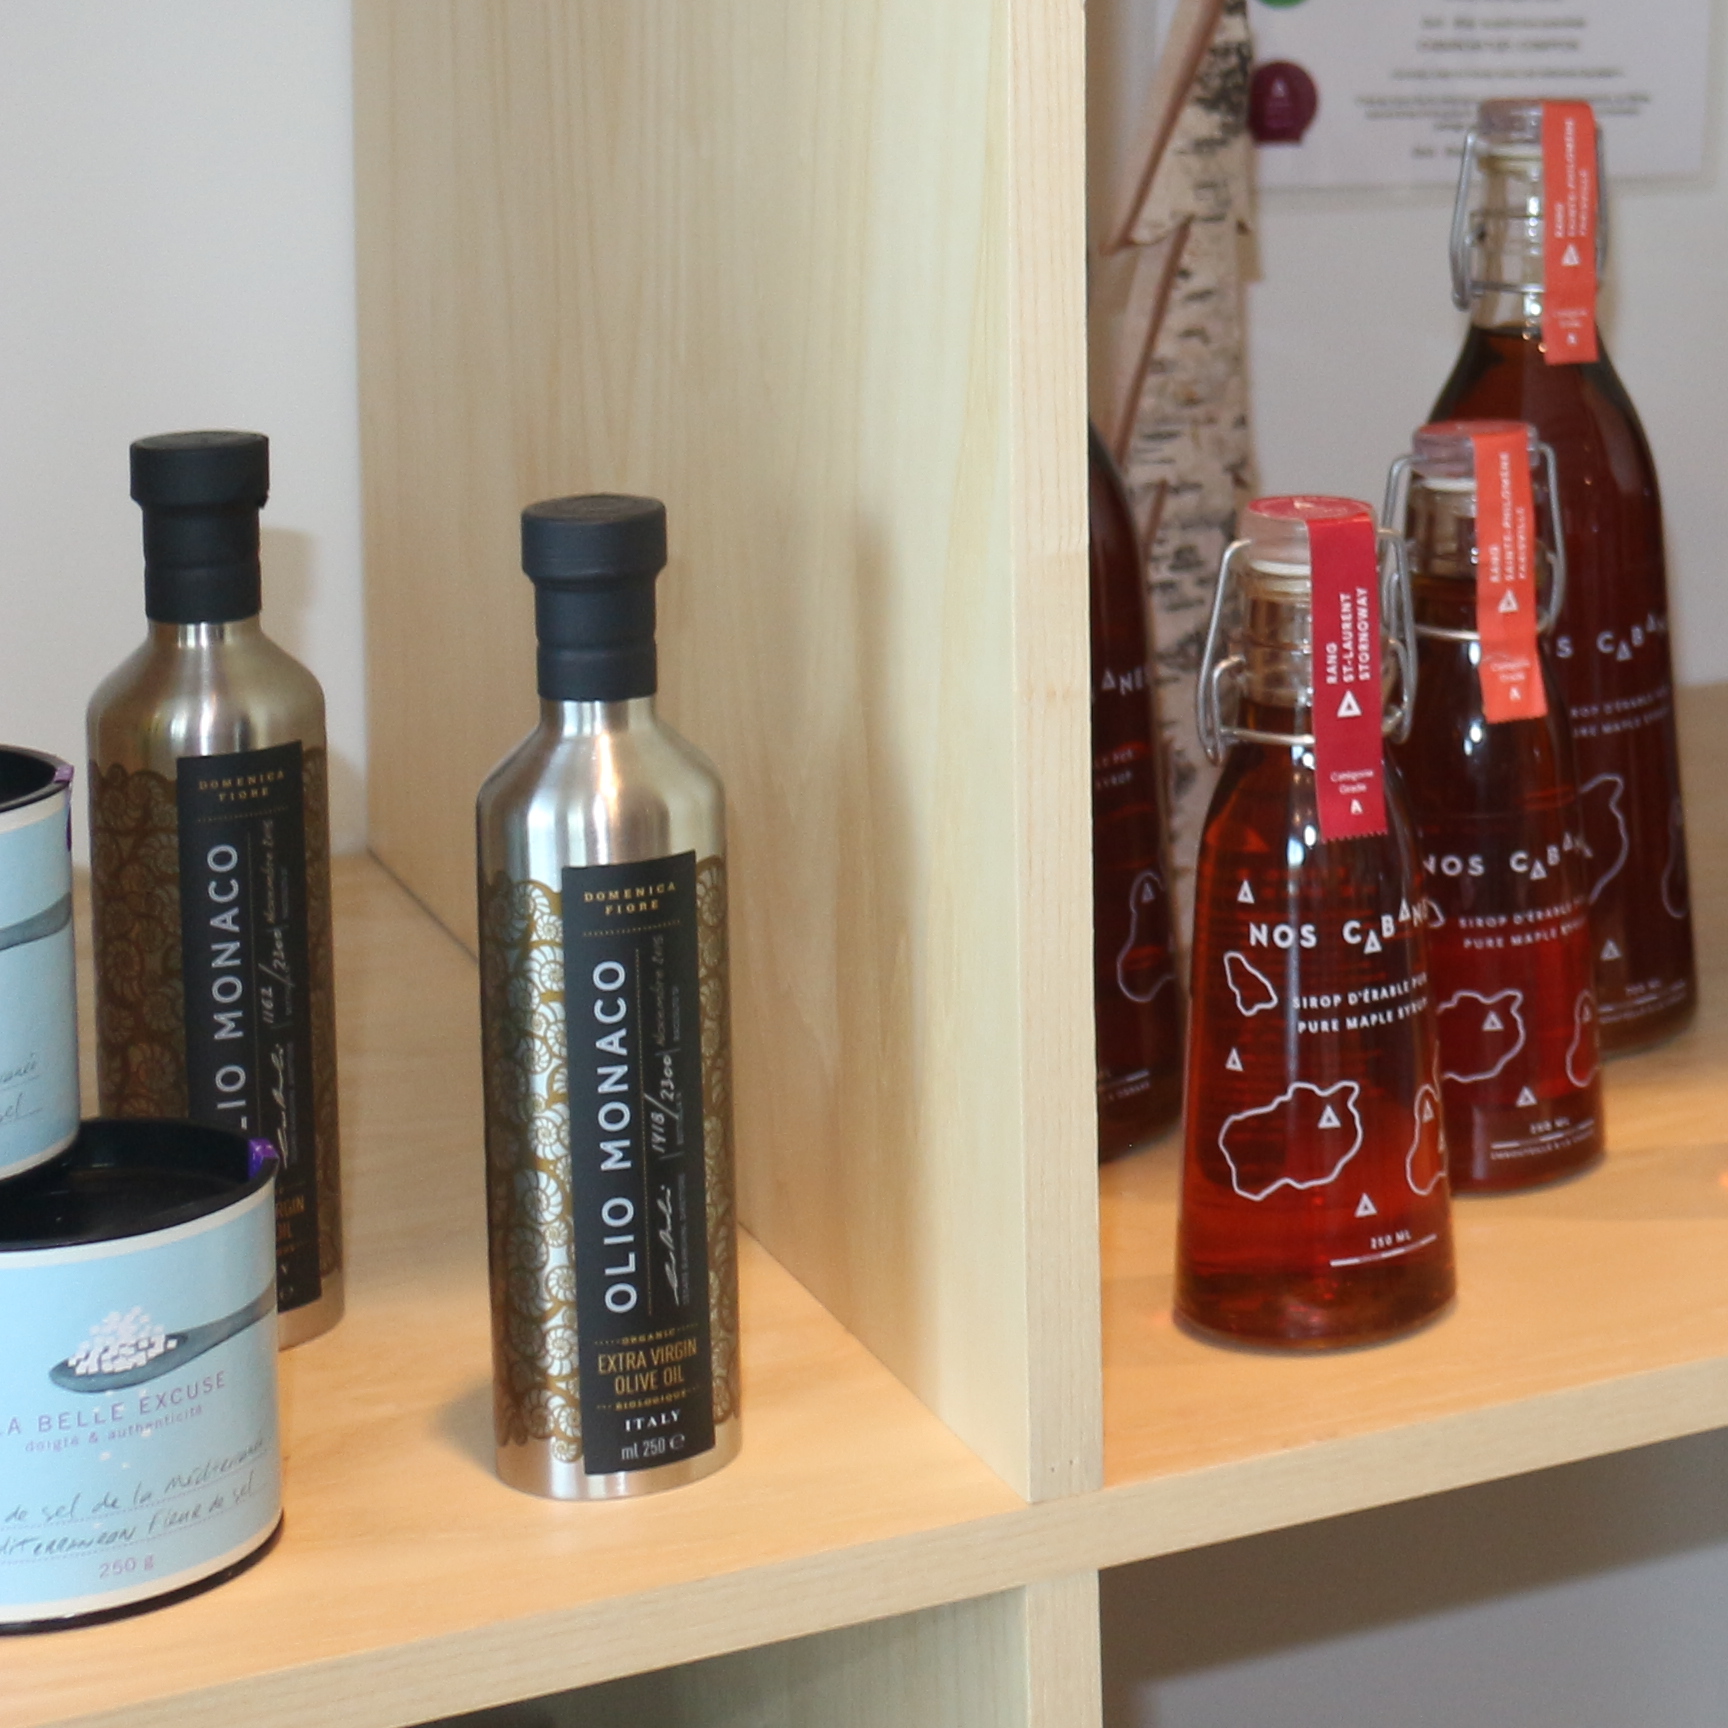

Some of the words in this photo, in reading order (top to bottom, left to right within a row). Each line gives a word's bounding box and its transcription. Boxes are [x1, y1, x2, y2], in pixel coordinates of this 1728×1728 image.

[1339, 592, 1355, 684] ST-LAURENT
[1356, 586, 1371, 681] STORNOWAY
[1596, 612, 1666, 662] CABA
[1326, 642, 1338, 685] RANG
[198, 769, 286, 791] DOMENICA
[218, 786, 270, 803] FIORE
[1350, 798, 1364, 815] A
[1422, 853, 1486, 877] NOS
[1508, 831, 1590, 881] CABA
[583, 881, 677, 904] DOMENICA
[604, 898, 660, 916] FIORE
[1249, 922, 1318, 949] NOS
[1342, 897, 1427, 955] CABAN
[1458, 915, 1507, 929] SIROP
[206, 843, 245, 1041] MONACO
[1462, 936, 1505, 950] PURE
[1509, 927, 1559, 947] MAPLE
[1292, 993, 1343, 1010] SIROP
[1348, 978, 1410, 1007] D'ÉRABLE
[1296, 1018, 1340, 1034] PURE
[1345, 1009, 1394, 1030] MAPLE
[592, 959, 633, 1172] MONACO
[600, 1196, 638, 1314] OLIO
[597, 1350, 648, 1375] EXTRA
[649, 1337, 698, 1366] VIRGIN
[614, 1368, 659, 1396] OLIVE
[662, 1364, 686, 1386] OIL
[38, 1401, 126, 1433] BELLE
[138, 1370, 227, 1417] EXCUSE
[624, 1409, 681, 1432] ITALY
[87, 1429, 99, 1445] &
[621, 1441, 639, 1460] ml
[642, 1436, 666, 1457] 250
[99, 1556, 137, 1579] 250
